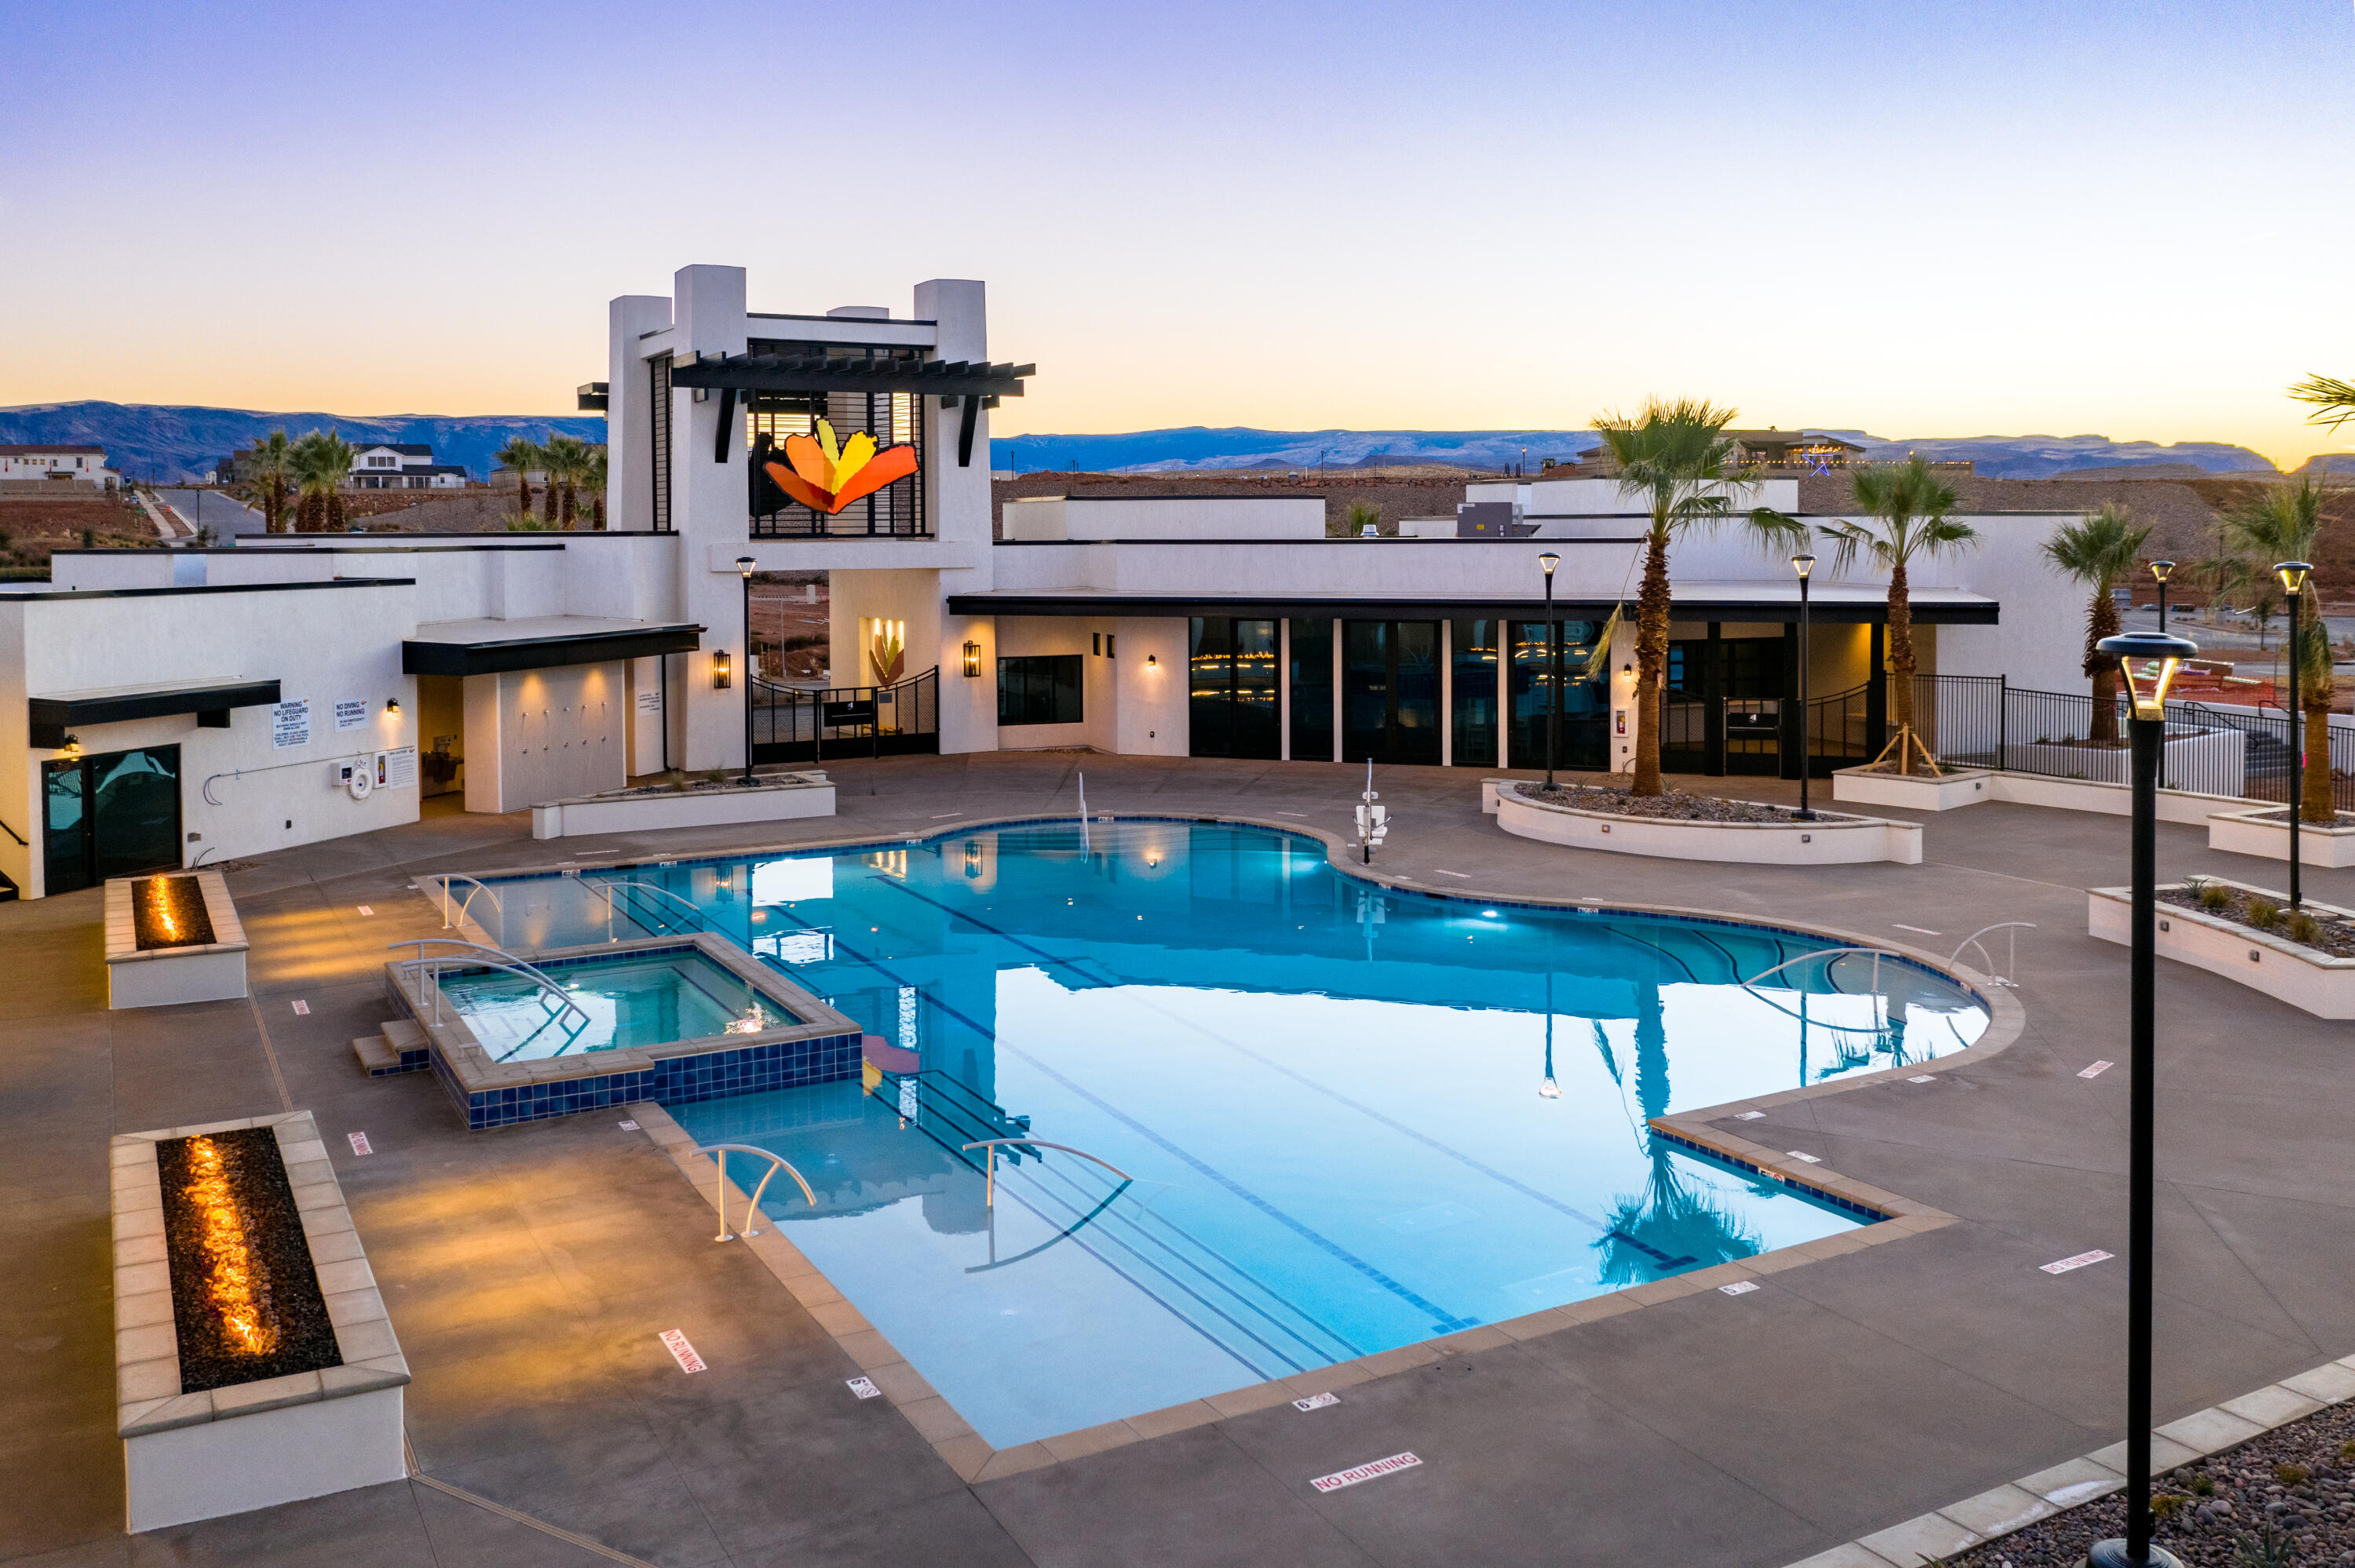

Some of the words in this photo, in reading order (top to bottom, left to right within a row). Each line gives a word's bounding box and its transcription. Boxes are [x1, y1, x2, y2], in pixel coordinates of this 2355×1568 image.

[283, 707, 309, 716] LIFEGUARD
[345, 708, 365, 717] RUNNING
[2059, 1250, 2109, 1266] RUNNING
[663, 1330, 681, 1341] NO
[670, 1340, 703, 1372] RUNNING
[1314, 1476, 1342, 1490] NO
[1342, 1454, 1418, 1482] RUNNING
